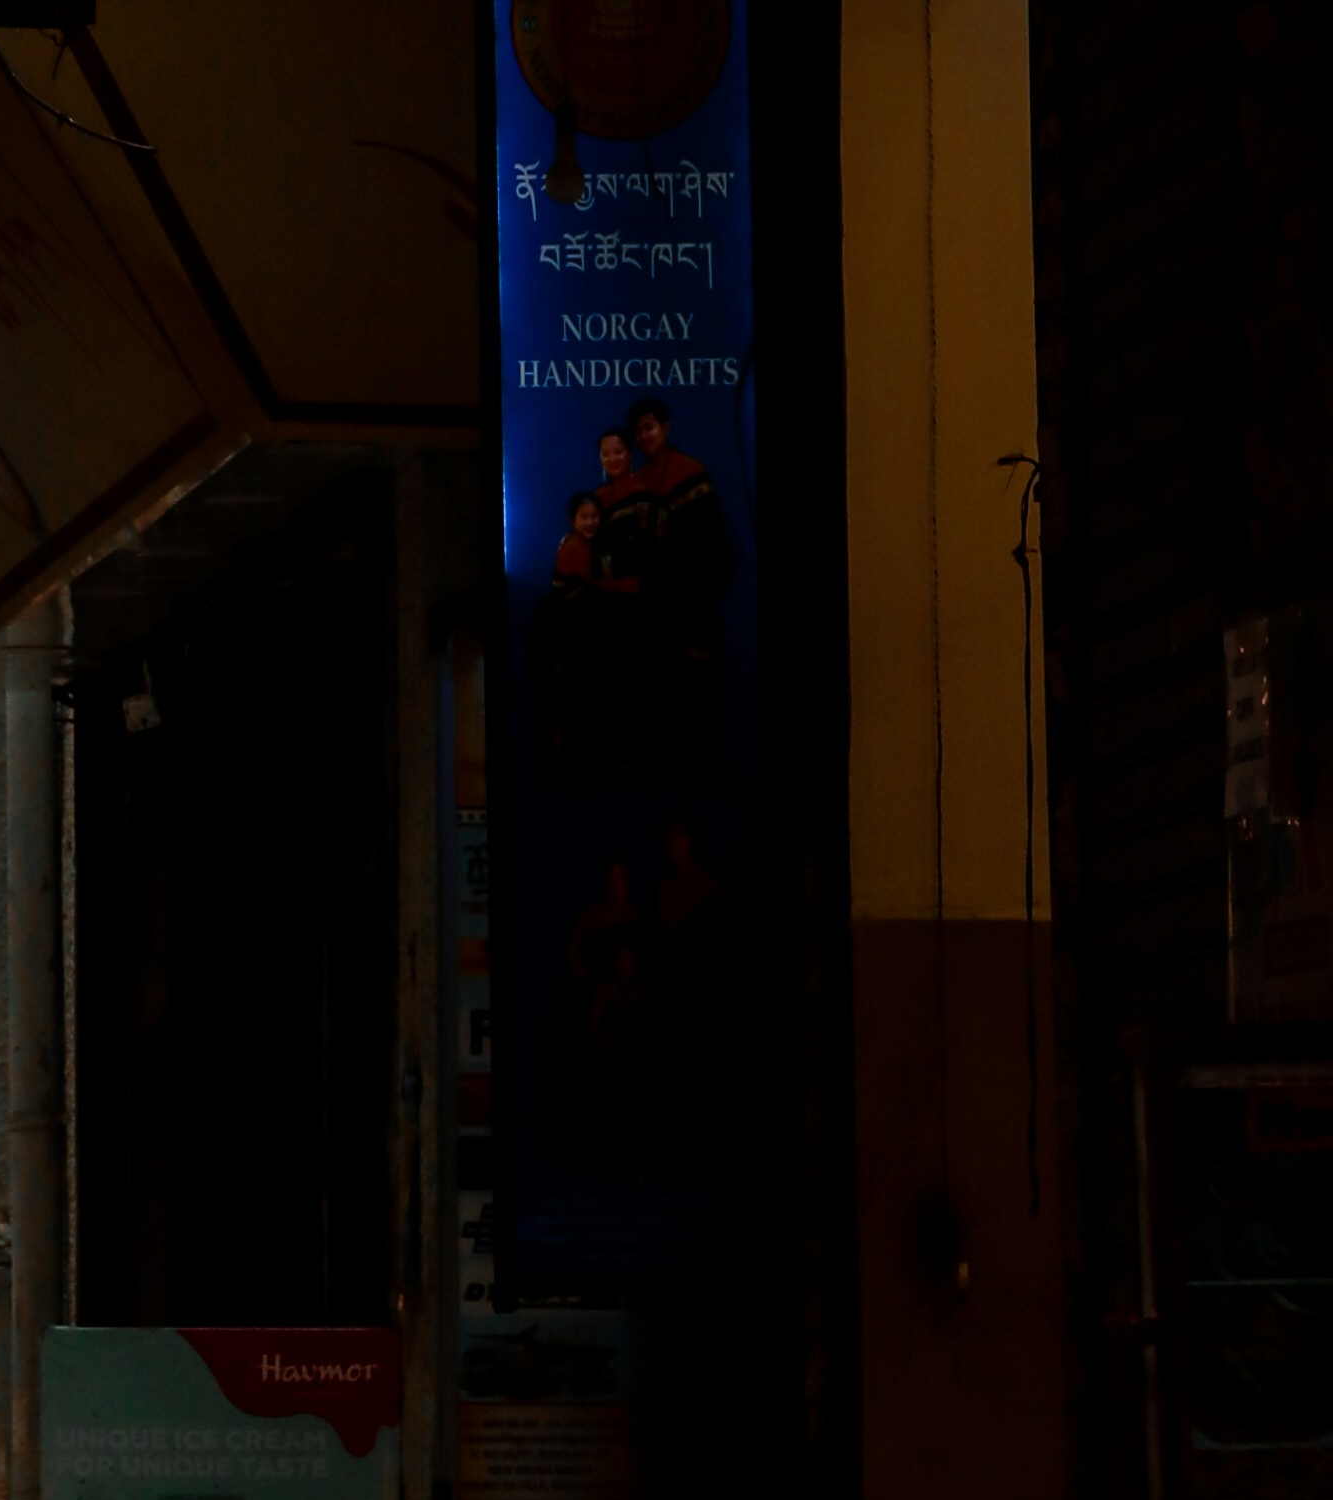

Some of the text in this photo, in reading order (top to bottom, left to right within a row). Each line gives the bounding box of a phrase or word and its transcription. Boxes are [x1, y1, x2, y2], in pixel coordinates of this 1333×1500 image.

[562, 312, 694, 342] NORGAY
[518, 357, 740, 388] HANDICRAFTS
[257, 1353, 379, 1383] Havmor
[57, 1428, 328, 1452] UNIQUE ICE CREAM
[56, 1457, 331, 1480] FOR UNIQUE TASTE
